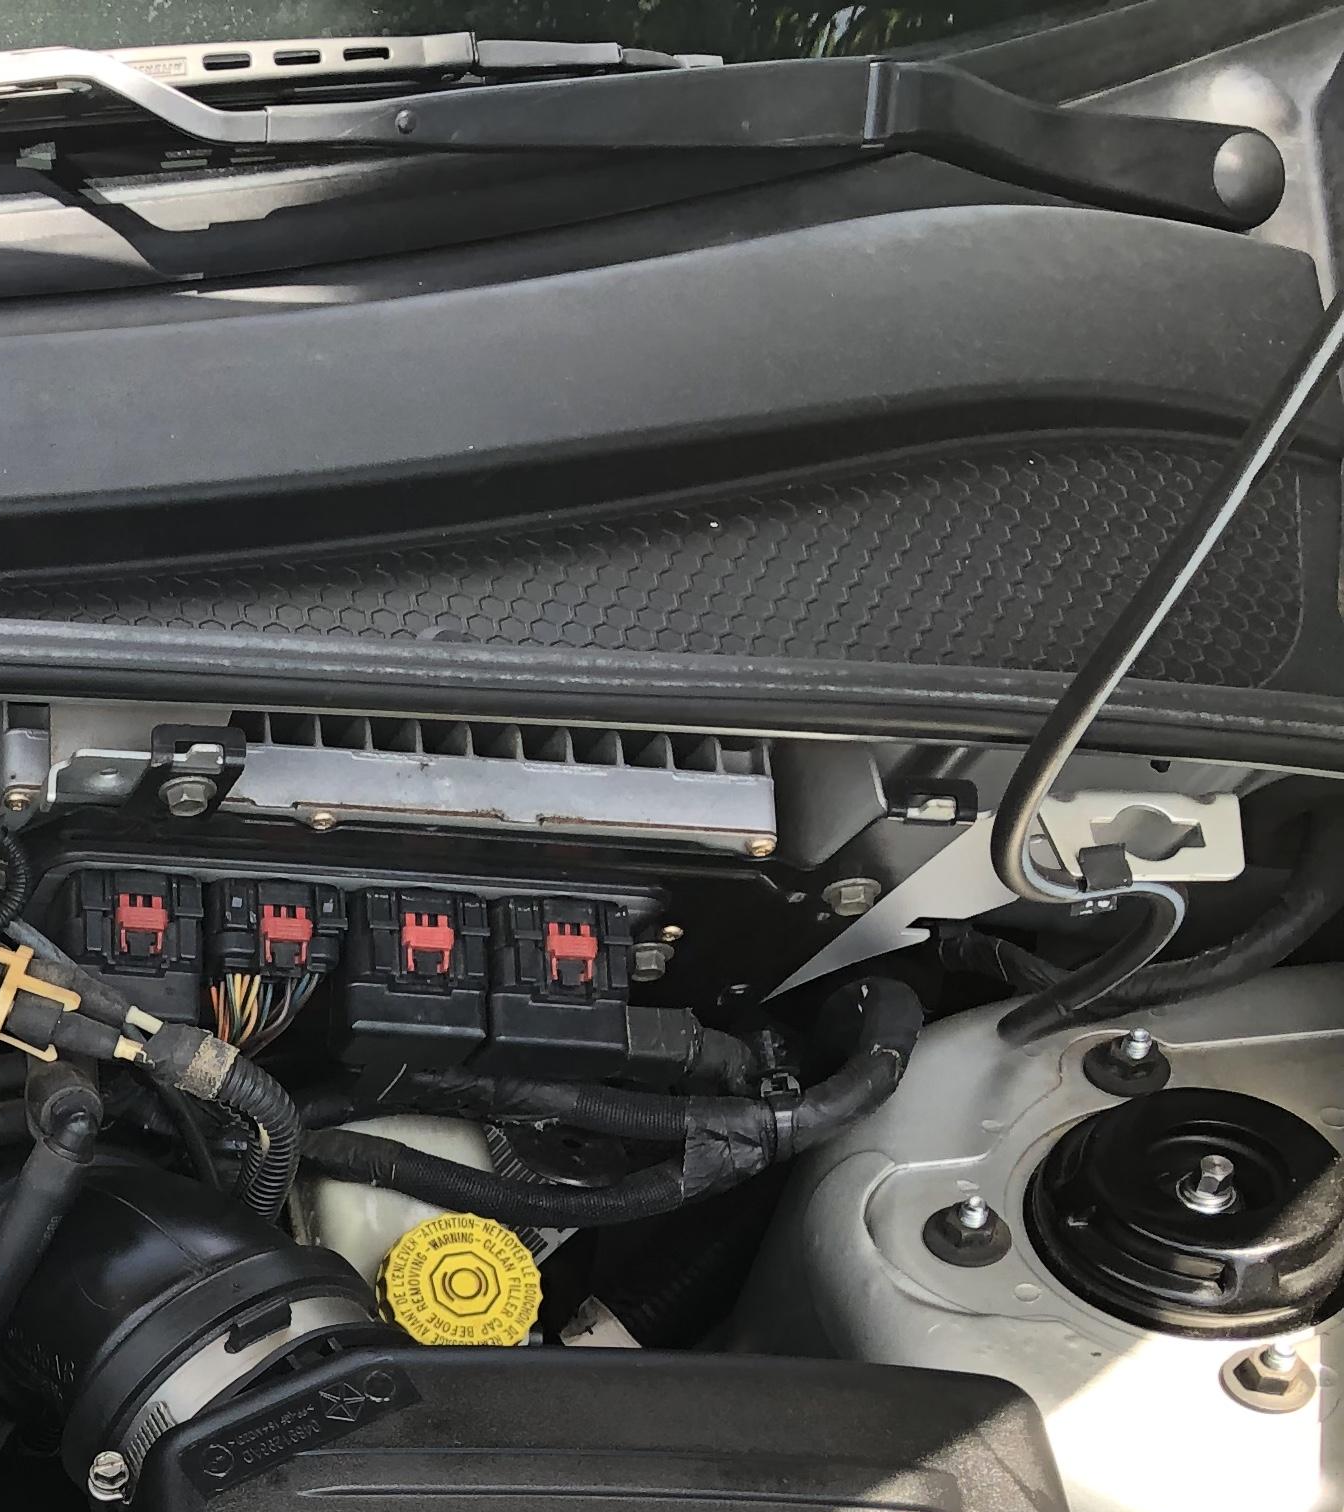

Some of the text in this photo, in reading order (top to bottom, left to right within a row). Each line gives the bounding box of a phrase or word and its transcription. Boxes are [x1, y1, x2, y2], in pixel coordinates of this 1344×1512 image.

[482, 1222, 529, 1263] NETTOYER
[483, 1238, 516, 1272] CLEAN
[406, 1251, 429, 1314] REMOVING
[522, 1264, 536, 1279] LE
[393, 1292, 407, 1306] DE
[500, 1276, 522, 1319] FILLER
[520, 1283, 538, 1329] BOUCHON
[403, 1308, 431, 1337] AVANT
[426, 1312, 475, 1338] BEFORE
[481, 1317, 503, 1336] CAP
